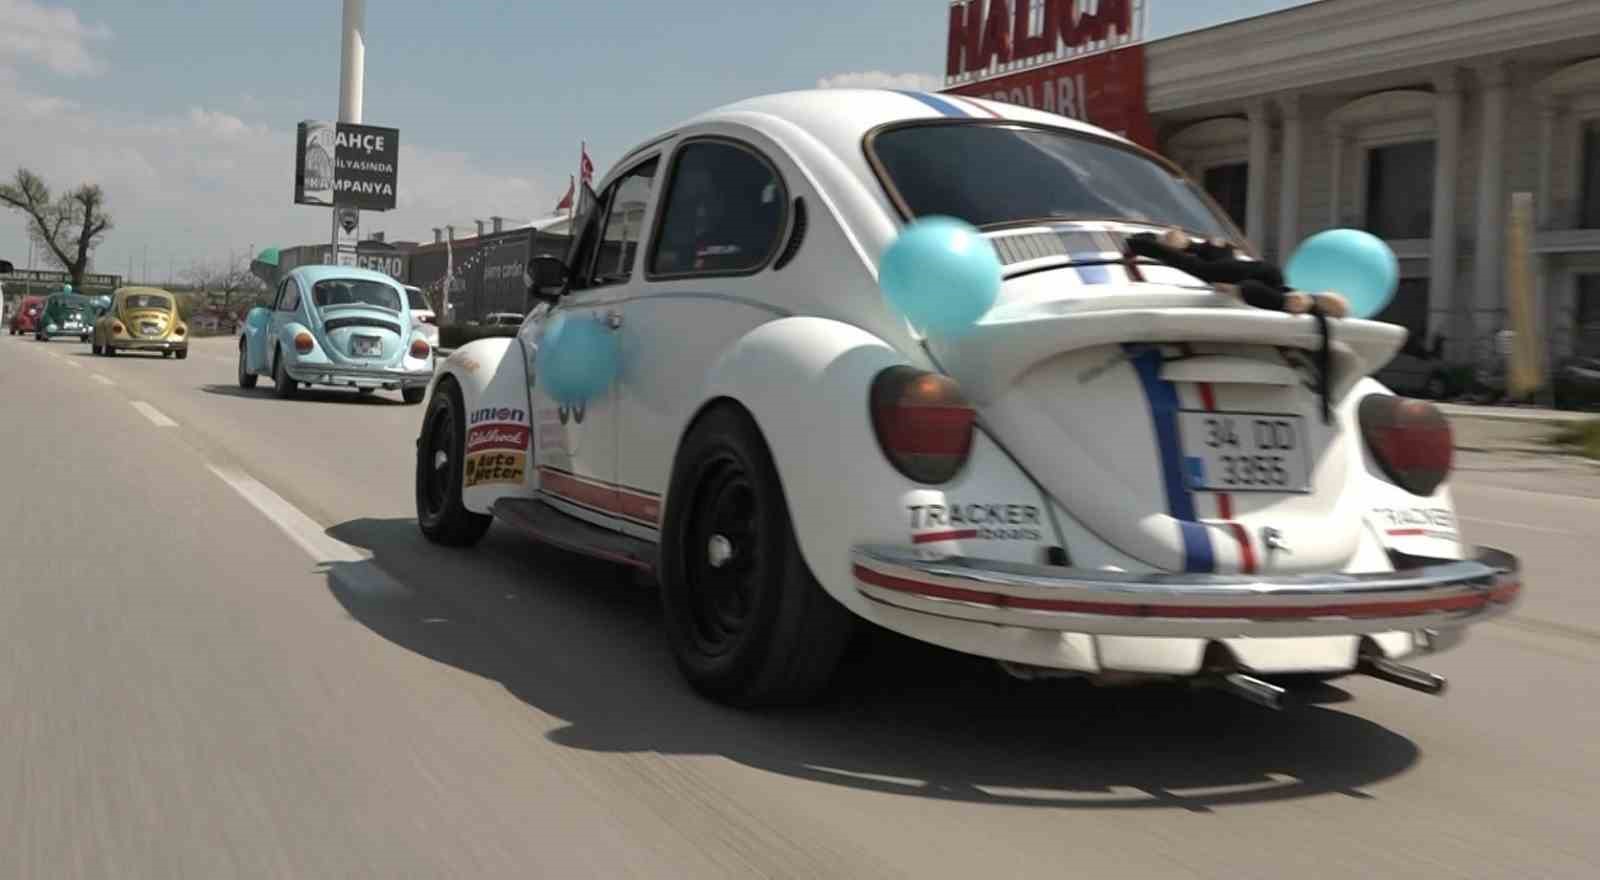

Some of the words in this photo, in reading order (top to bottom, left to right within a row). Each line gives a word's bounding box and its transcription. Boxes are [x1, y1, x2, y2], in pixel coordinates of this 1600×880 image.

[335, 132, 384, 154] AHÇE
[336, 157, 393, 172] İLYASINDA
[471, 408, 524, 424] union
[1205, 418, 1240, 448] 34
[1253, 419, 1295, 450] DD
[478, 454, 515, 466] Auto
[475, 467, 523, 480] Meter
[1220, 455, 1288, 485] 3355
[907, 503, 1040, 528] TRACKER
